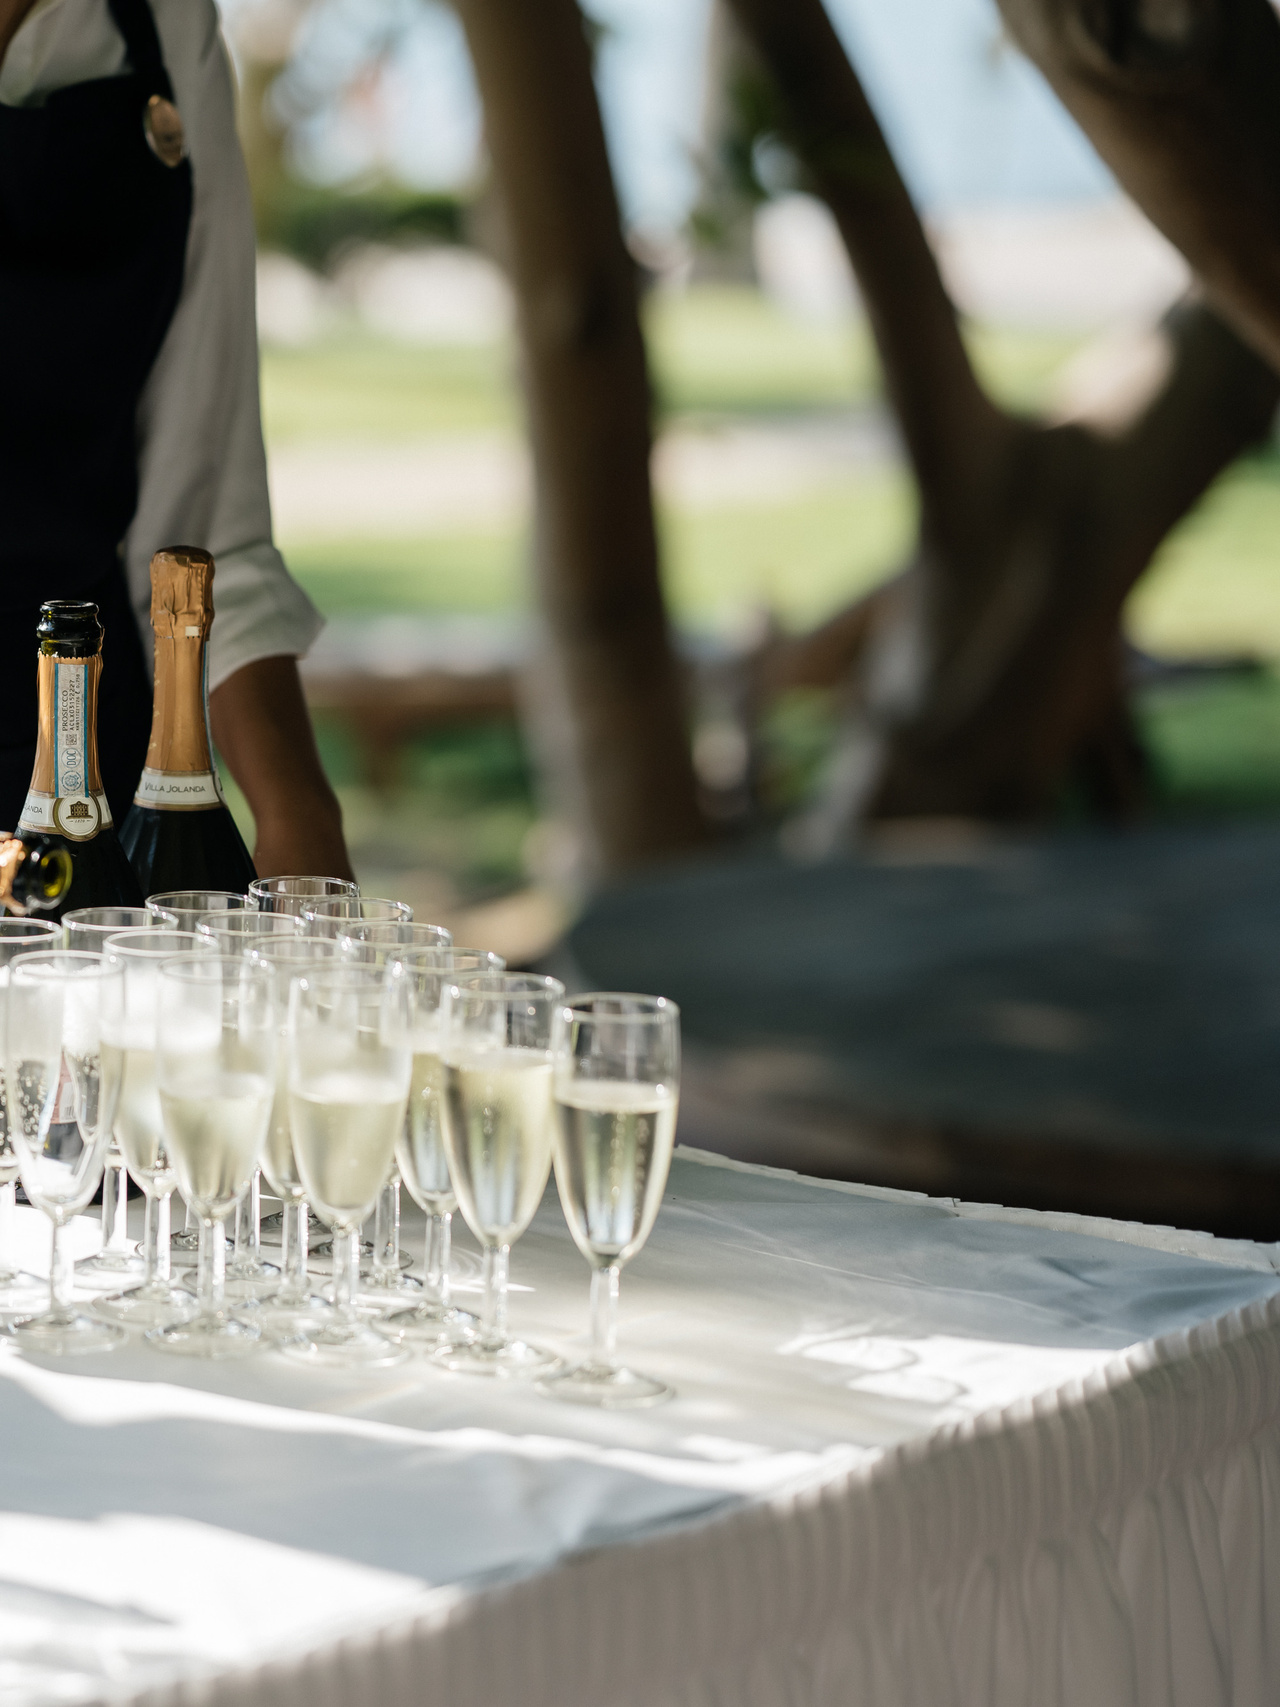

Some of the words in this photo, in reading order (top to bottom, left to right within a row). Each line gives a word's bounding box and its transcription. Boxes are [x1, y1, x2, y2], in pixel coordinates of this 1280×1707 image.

[66, 751, 77, 766] DOC
[145, 782, 165, 792] VILLA
[166, 784, 206, 794] JOLANDA
